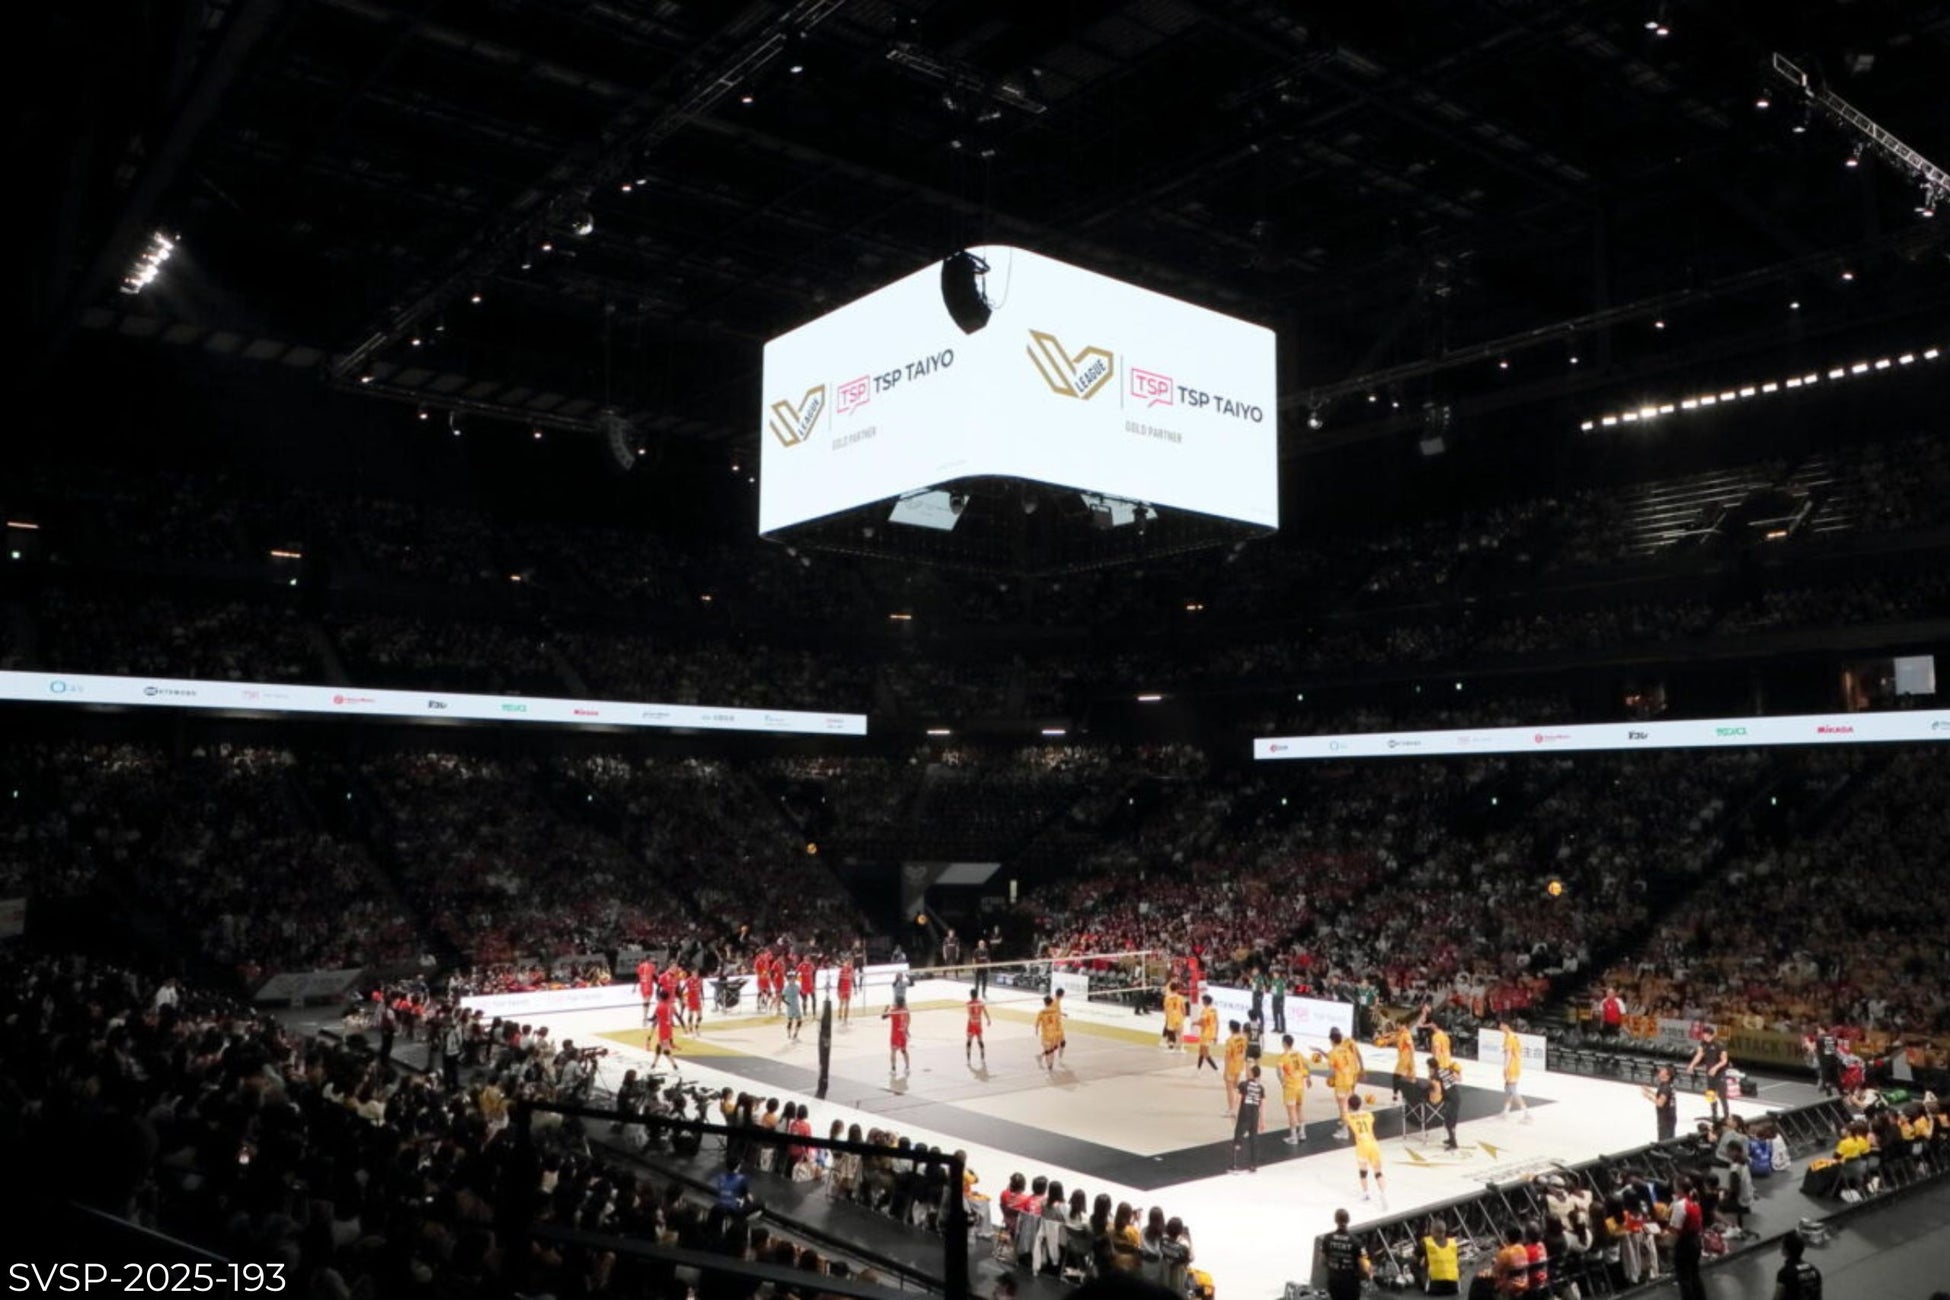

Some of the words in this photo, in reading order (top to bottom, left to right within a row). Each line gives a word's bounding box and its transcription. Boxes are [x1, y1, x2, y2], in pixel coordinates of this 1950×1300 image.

[873, 368, 903, 393] TSP
[905, 349, 954, 382] TAIYO
[1075, 359, 1107, 393] LEAGUE
[1135, 375, 1169, 397] TSP
[840, 382, 866, 405] TSP
[1177, 386, 1210, 409] TSP
[1213, 396, 1264, 423] TAIYO
[798, 397, 820, 437] LEAGUE
[1125, 420, 1148, 436] GOLD
[1148, 427, 1183, 444] PARTNER
